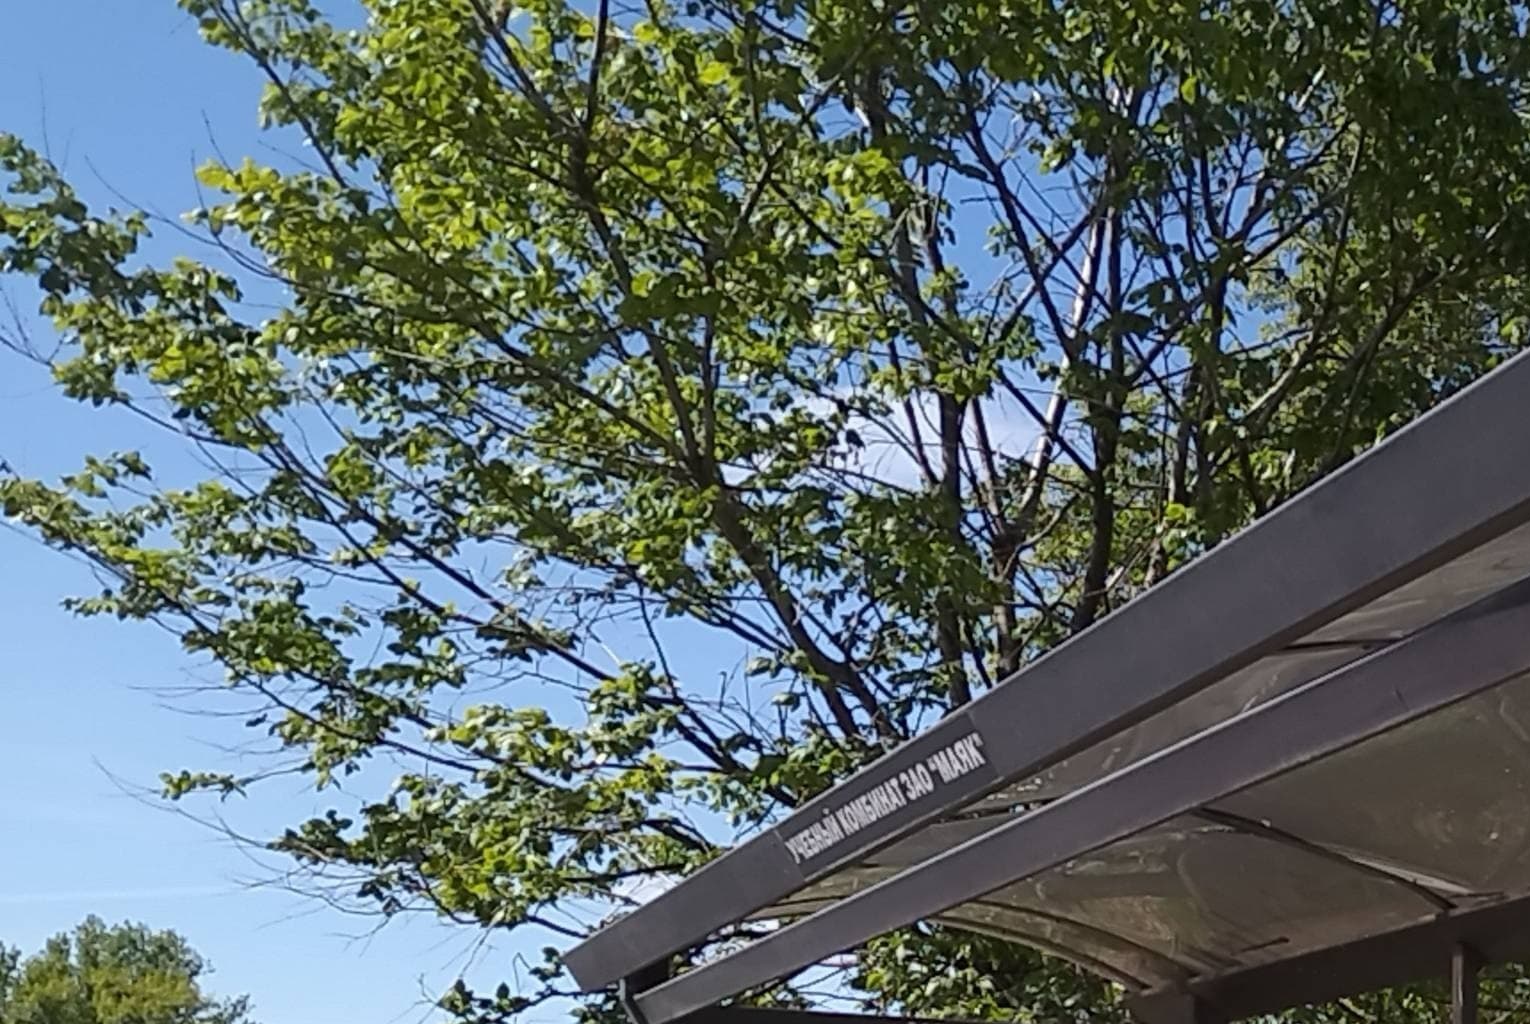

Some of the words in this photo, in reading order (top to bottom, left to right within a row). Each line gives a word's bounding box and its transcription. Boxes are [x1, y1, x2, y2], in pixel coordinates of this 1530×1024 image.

[784, 807, 844, 863] УЧЕБНЫЙ
[836, 777, 908, 836] КОМБИНАТ
[900, 762, 935, 801] ЗАО
